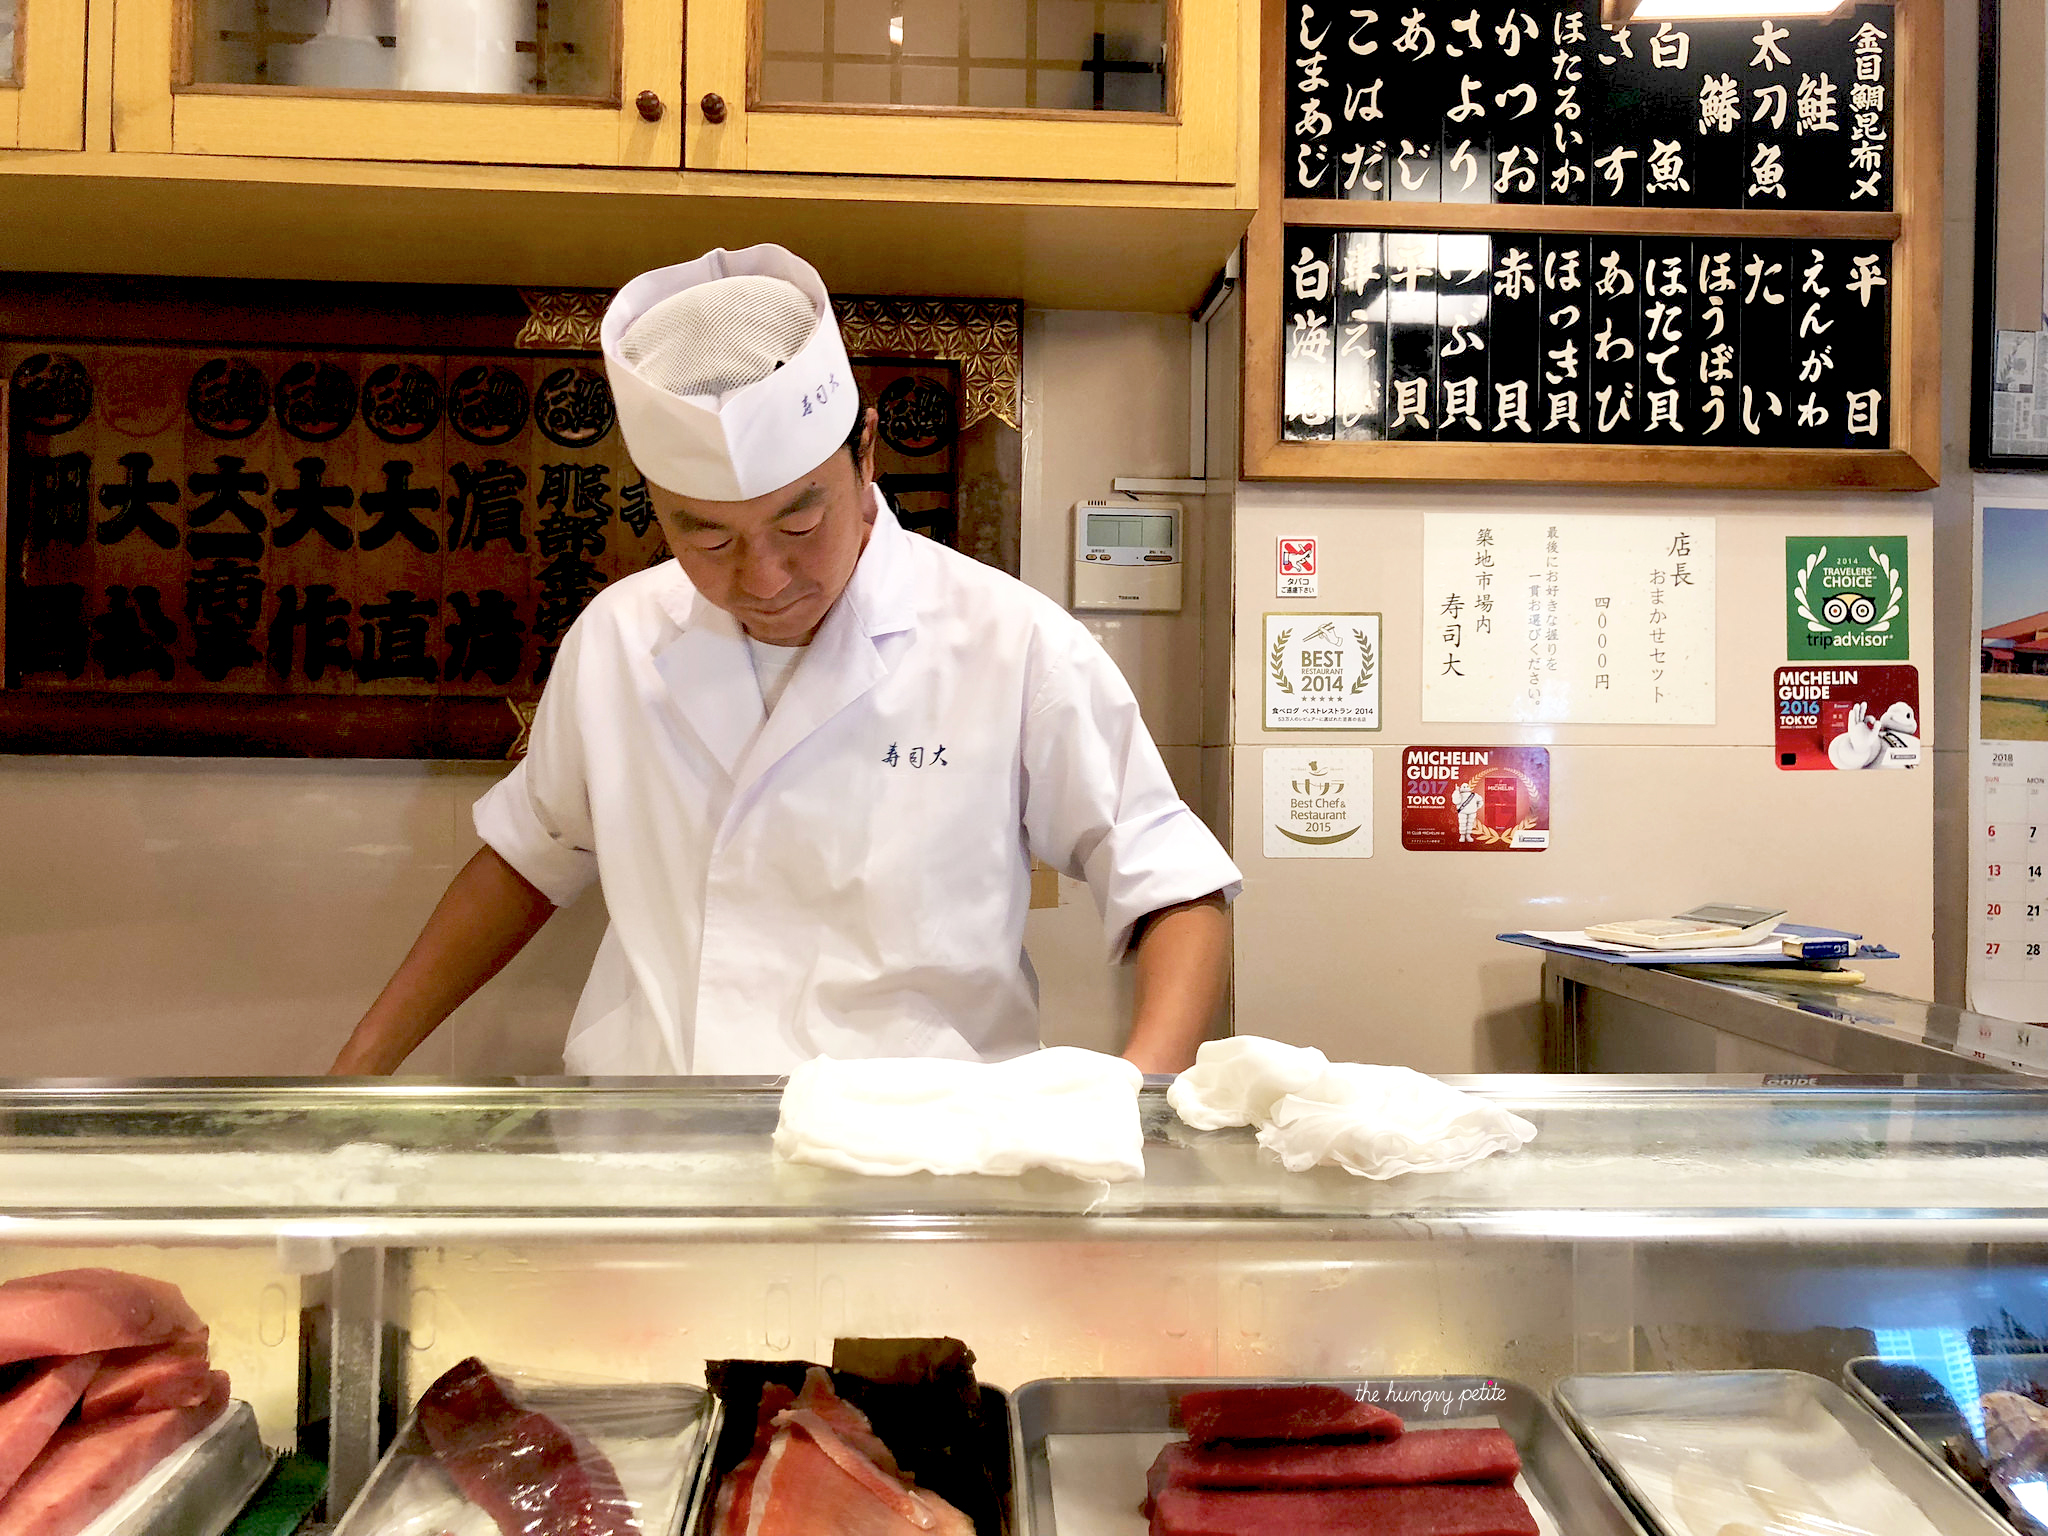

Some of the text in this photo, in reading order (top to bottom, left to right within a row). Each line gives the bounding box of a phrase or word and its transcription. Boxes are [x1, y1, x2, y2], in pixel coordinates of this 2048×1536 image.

[1295, 4, 1332, 188] しまあじ
[1342, 9, 1386, 191] こはだ
[1392, 8, 1435, 191] あじ
[1446, 9, 1486, 192] さより
[1494, 8, 1539, 193] かつお
[1550, 12, 1586, 194] ほたるいか
[1646, 22, 1690, 193] 白魚
[1698, 72, 1741, 135] 鰆
[1748, 19, 1792, 199] 太刀魚
[1797, 72, 1839, 136] 鮭
[1492, 247, 1535, 433] 赤貝
[1542, 250, 1581, 433] ほっき貝
[1594, 251, 1634, 432] あわび
[1644, 257, 1688, 432] ほたて貝
[1699, 252, 1736, 435] ほうぼう
[1742, 254, 1785, 435] たい
[1798, 249, 1834, 427] えんがわ
[1846, 254, 1887, 436] 平目
[1288, 577, 1309, 585] タバコ
[1474, 528, 1494, 634] 築地市場内
[1668, 532, 1695, 587] 店長
[1823, 576, 1873, 588] CHOICE
[1545, 526, 1559, 671] 最後にお好きな握りを
[1301, 650, 1344, 667] BEST
[1440, 593, 1465, 676] 寿司大
[1528, 574, 1542, 706] 一貫お選びください。
[1649, 568, 1667, 703] おまかせセット
[1807, 631, 1889, 650] tripadvisor
[1301, 675, 1344, 692] 2014
[1778, 670, 1858, 686] MICHELIN
[1778, 686, 1830, 700] GUIDE
[1272, 707, 1299, 715] 食べログ
[1302, 707, 1352, 715] ベストレストラン
[1779, 700, 1820, 715] 2016
[1779, 715, 1818, 725] TOKYO
[881, 742, 948, 768] 寿司大
[1406, 751, 1489, 766] MICHELIN
[1406, 766, 1460, 780] GUIDE
[1993, 753, 2013, 762] 2018
[1290, 799, 1313, 808] Best
[1315, 798, 1340, 808] Chef
[1290, 810, 1346, 820] Restaurant
[1407, 781, 1448, 794] 2017
[1407, 795, 1446, 805] TOKYO
[1305, 822, 1331, 832] 2015
[1988, 825, 2037, 838] 6 7
[1988, 864, 2042, 877] 13 14
[1987, 904, 2040, 916] 20 21
[1986, 942, 2040, 955] 27 28
